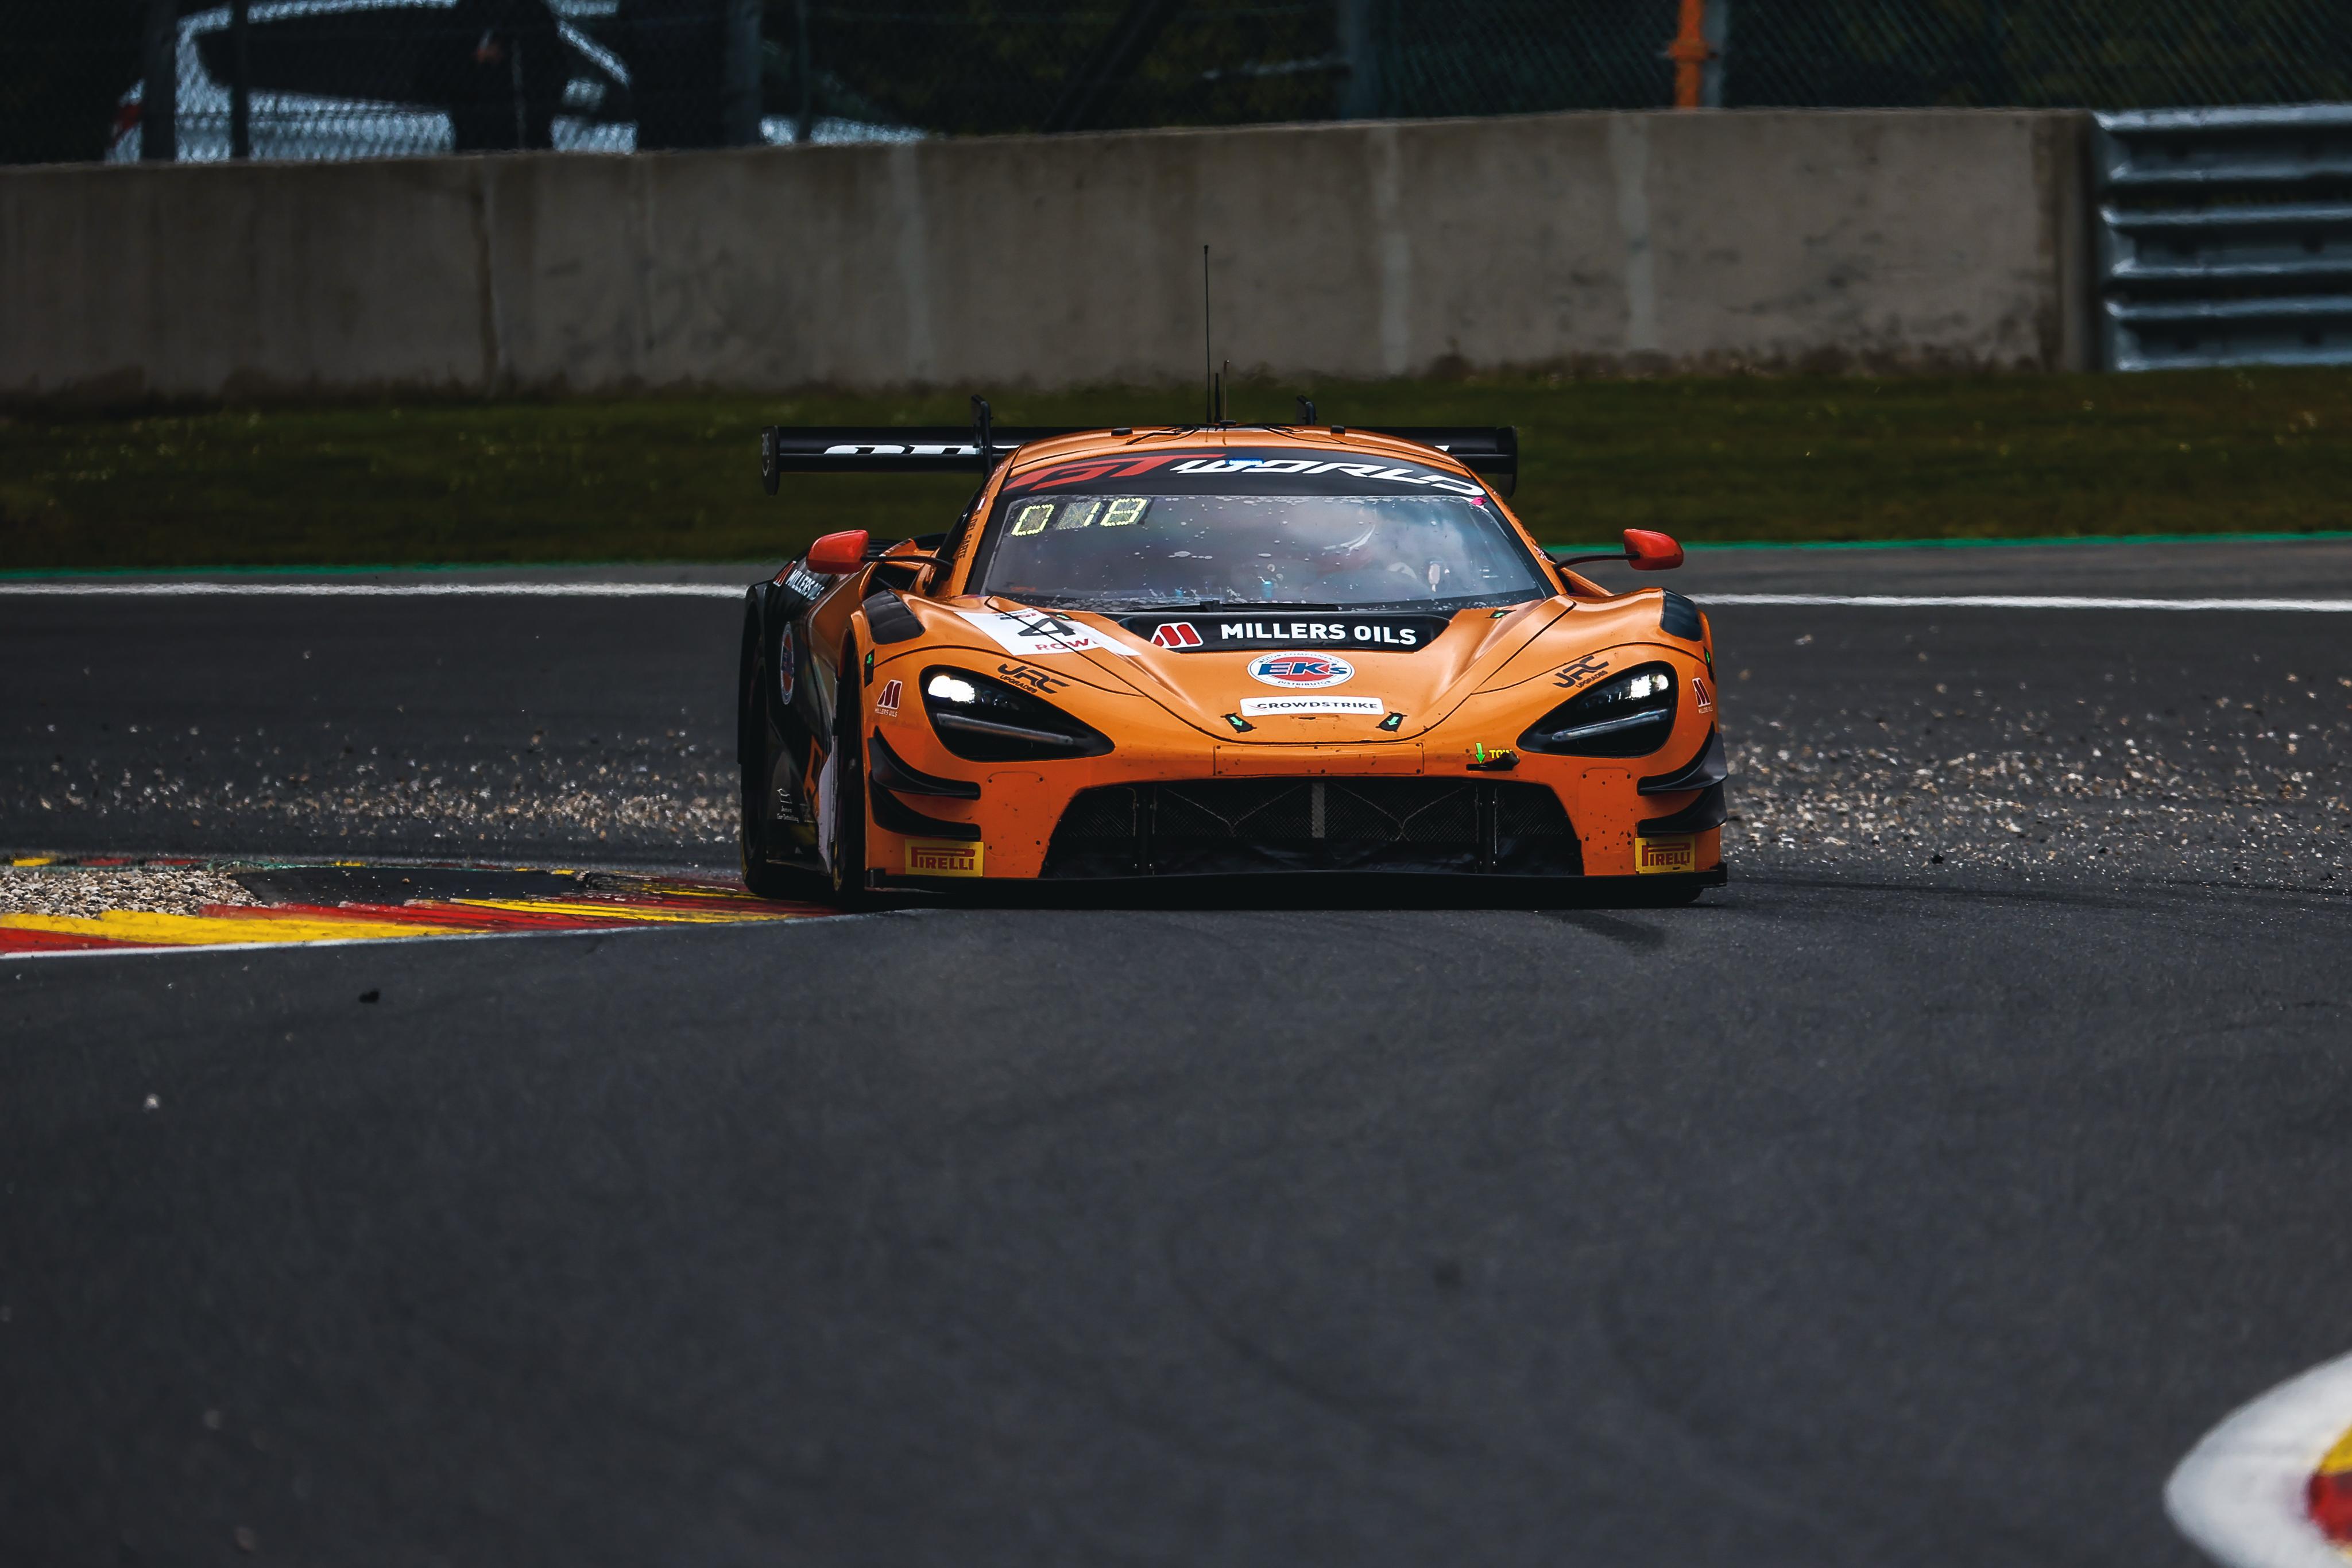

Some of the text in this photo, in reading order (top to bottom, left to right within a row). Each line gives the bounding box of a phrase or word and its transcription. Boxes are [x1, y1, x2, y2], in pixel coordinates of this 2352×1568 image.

[1170, 459, 1486, 496] WORLD
[1018, 617, 1076, 637] 4
[1221, 622, 1417, 645] MILLERS OILS
[1035, 638, 1097, 651] ROW
[997, 663, 1070, 694] JRC
[1258, 663, 1348, 676] EK's
[1553, 655, 1609, 688] JRC
[1257, 701, 1378, 710] CROWDSTRIKE
[911, 846, 976, 870] PIRELLI
[1642, 843, 1691, 866] PIRELLI
